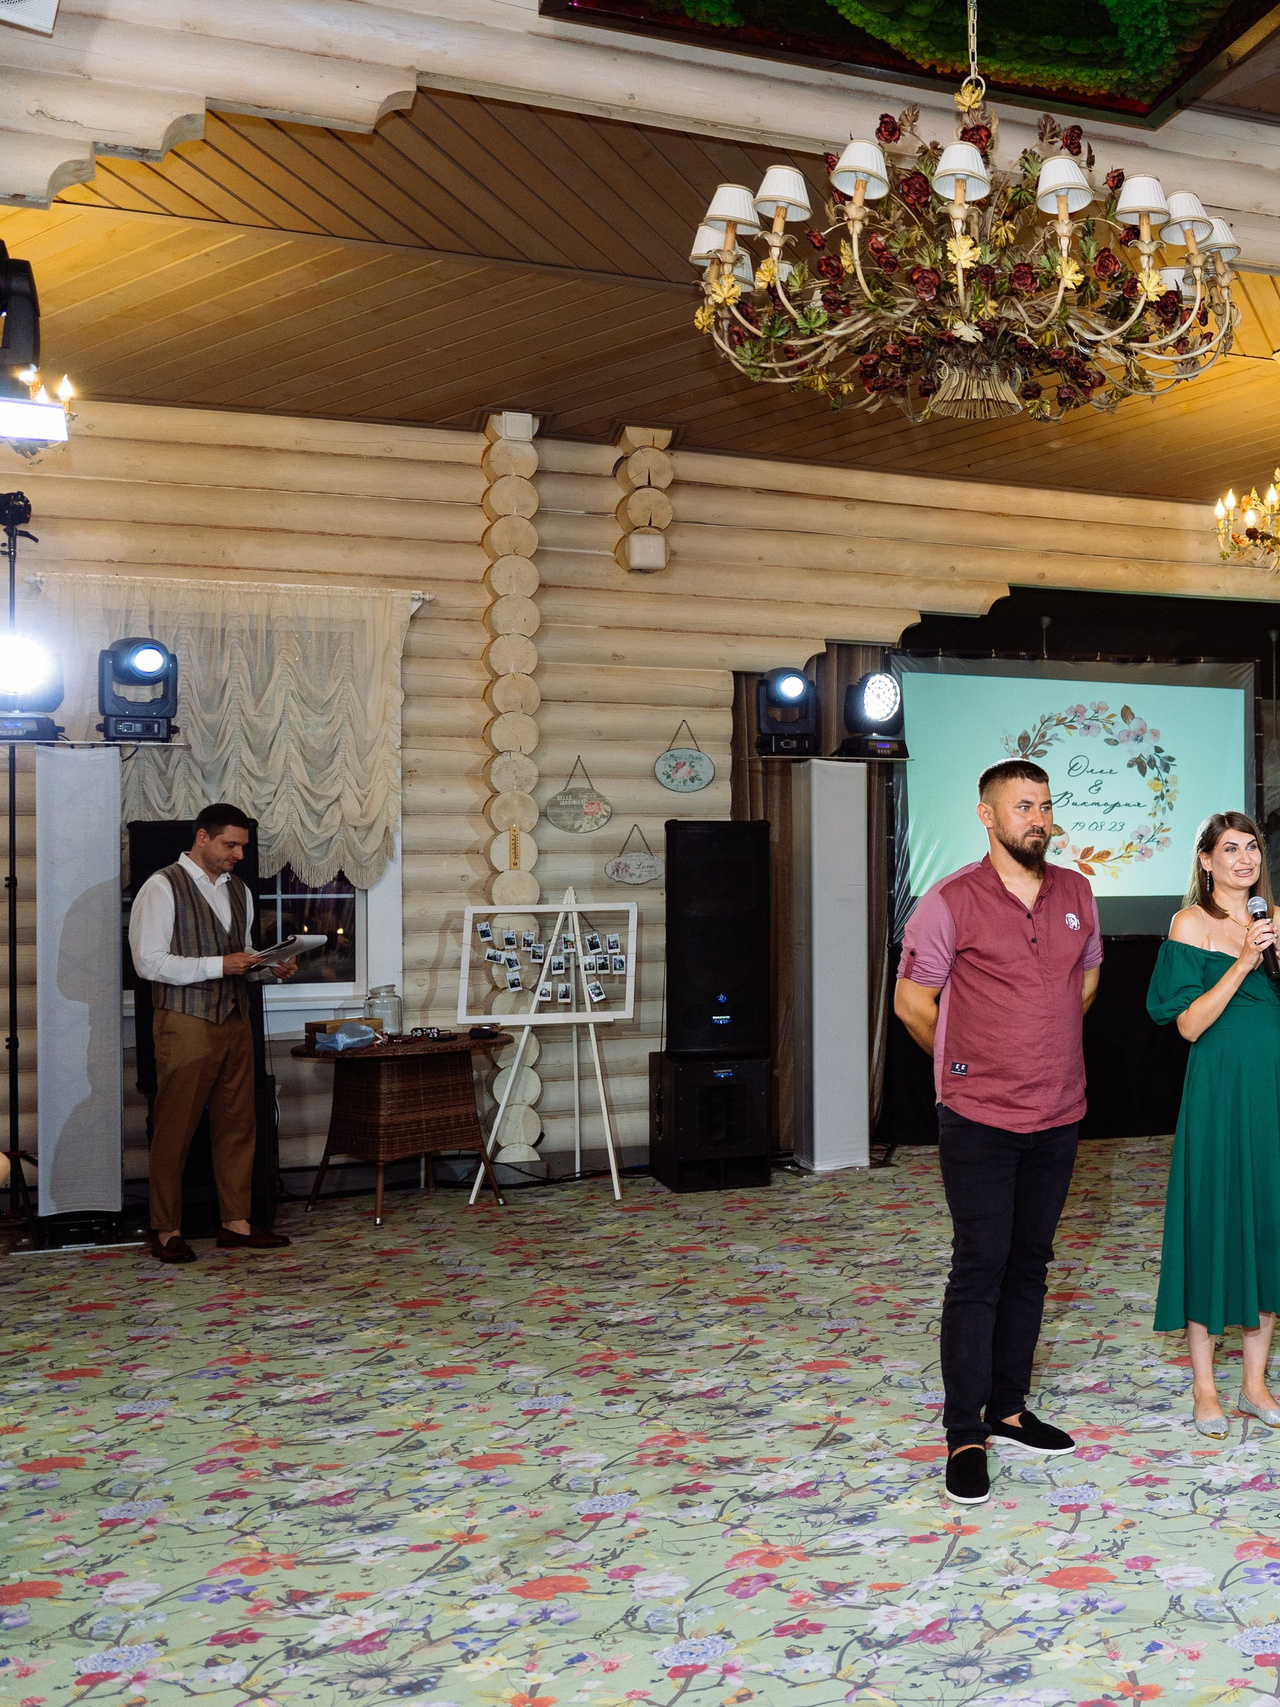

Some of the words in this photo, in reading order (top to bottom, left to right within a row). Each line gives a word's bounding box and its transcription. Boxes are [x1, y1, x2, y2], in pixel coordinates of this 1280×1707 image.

[1068, 755, 1118, 777] Олег
[1088, 780, 1103, 794] &
[1051, 791, 1147, 814] Виктория
[1070, 821, 1126, 832] 19.08.23
